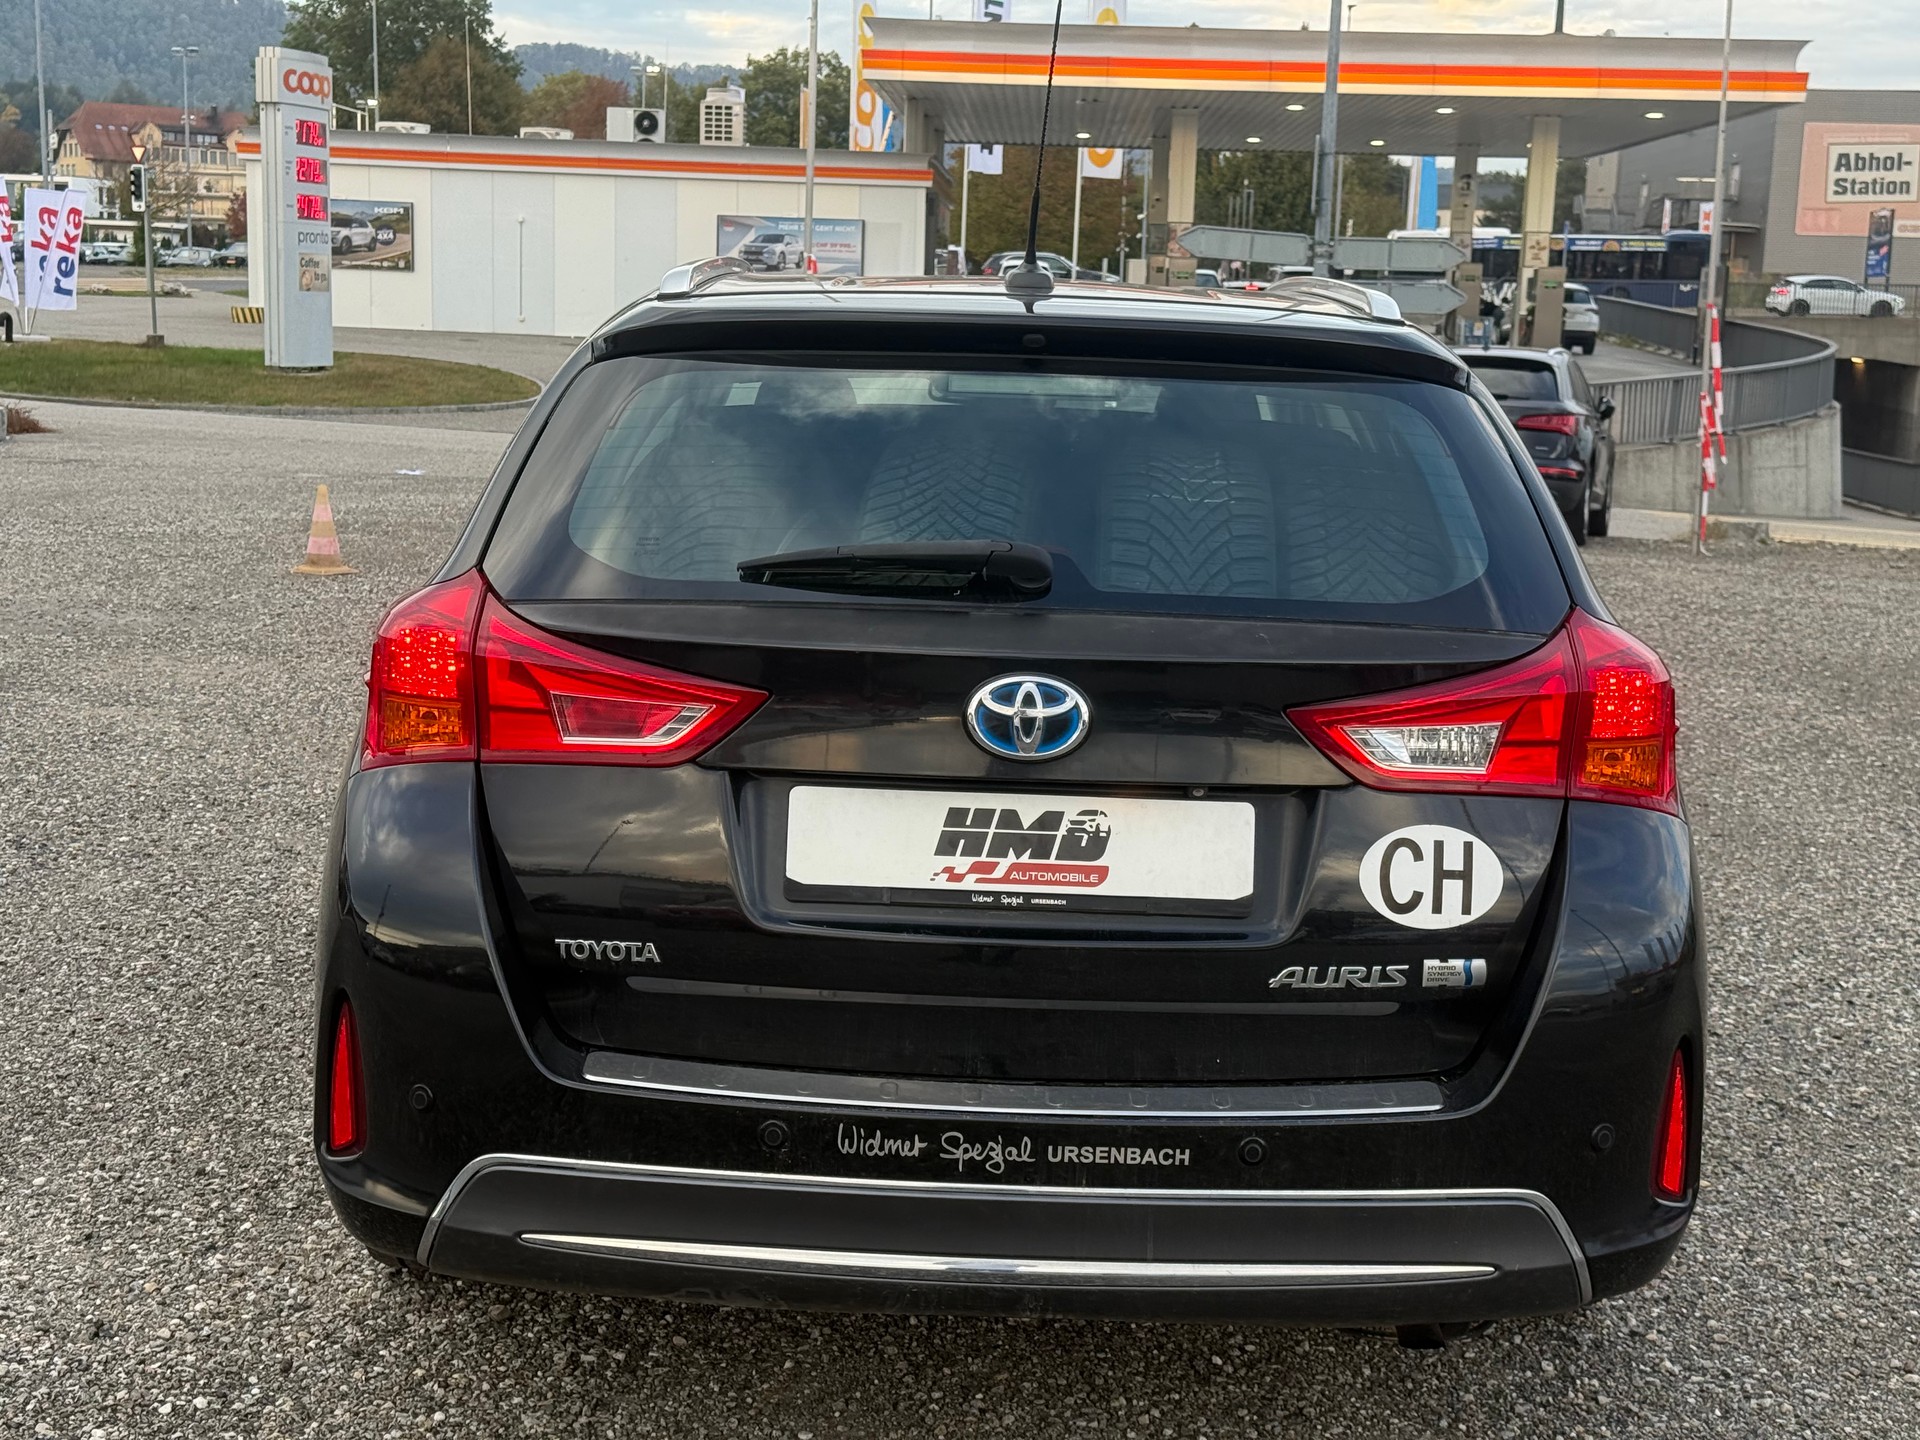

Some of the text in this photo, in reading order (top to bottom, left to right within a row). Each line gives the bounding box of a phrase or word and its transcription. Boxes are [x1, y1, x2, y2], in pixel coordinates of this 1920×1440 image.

[283, 69, 331, 105] coop
[1834, 152, 1912, 172] Abhol-
[1833, 177, 1911, 195] Station
[298, 230, 329, 246] pronto
[53, 207, 83, 297] reka
[300, 257, 320, 268] Coffee
[1010, 870, 1099, 883] AUTOMOBILE
[1379, 837, 1474, 916] CH
[1031, 898, 1067, 906] URSENBACH
[555, 939, 661, 962] TOYOTA
[1268, 965, 1410, 989] AURIS
[1048, 1144, 1191, 1167] URSENBACH
